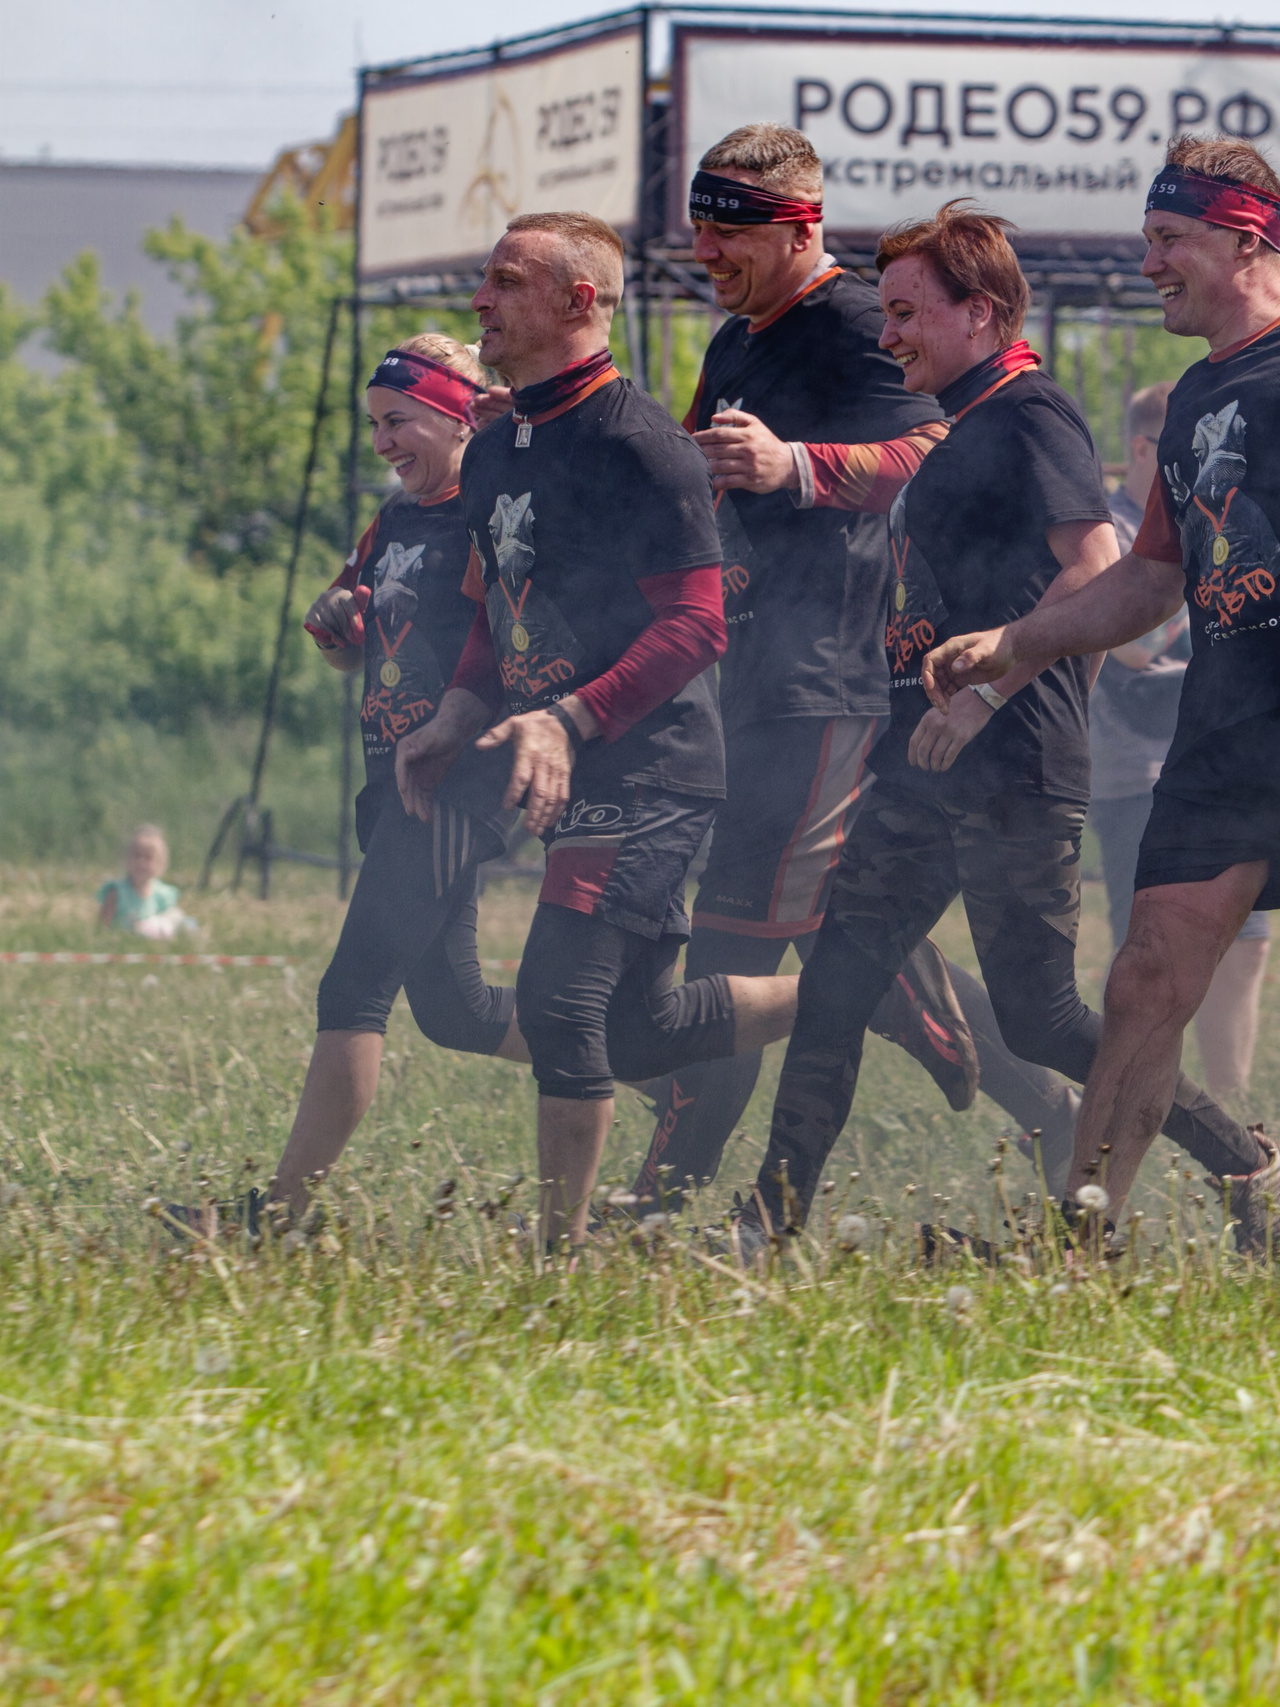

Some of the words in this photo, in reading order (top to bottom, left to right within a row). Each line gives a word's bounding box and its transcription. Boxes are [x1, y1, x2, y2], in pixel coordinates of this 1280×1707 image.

[794, 79, 1274, 148] РОДЕО59.РФ
[820, 156, 1139, 194] кстремальный
[1158, 183, 1177, 195] 59
[716, 197, 740, 209] 59
[383, 357, 399, 366] 59
